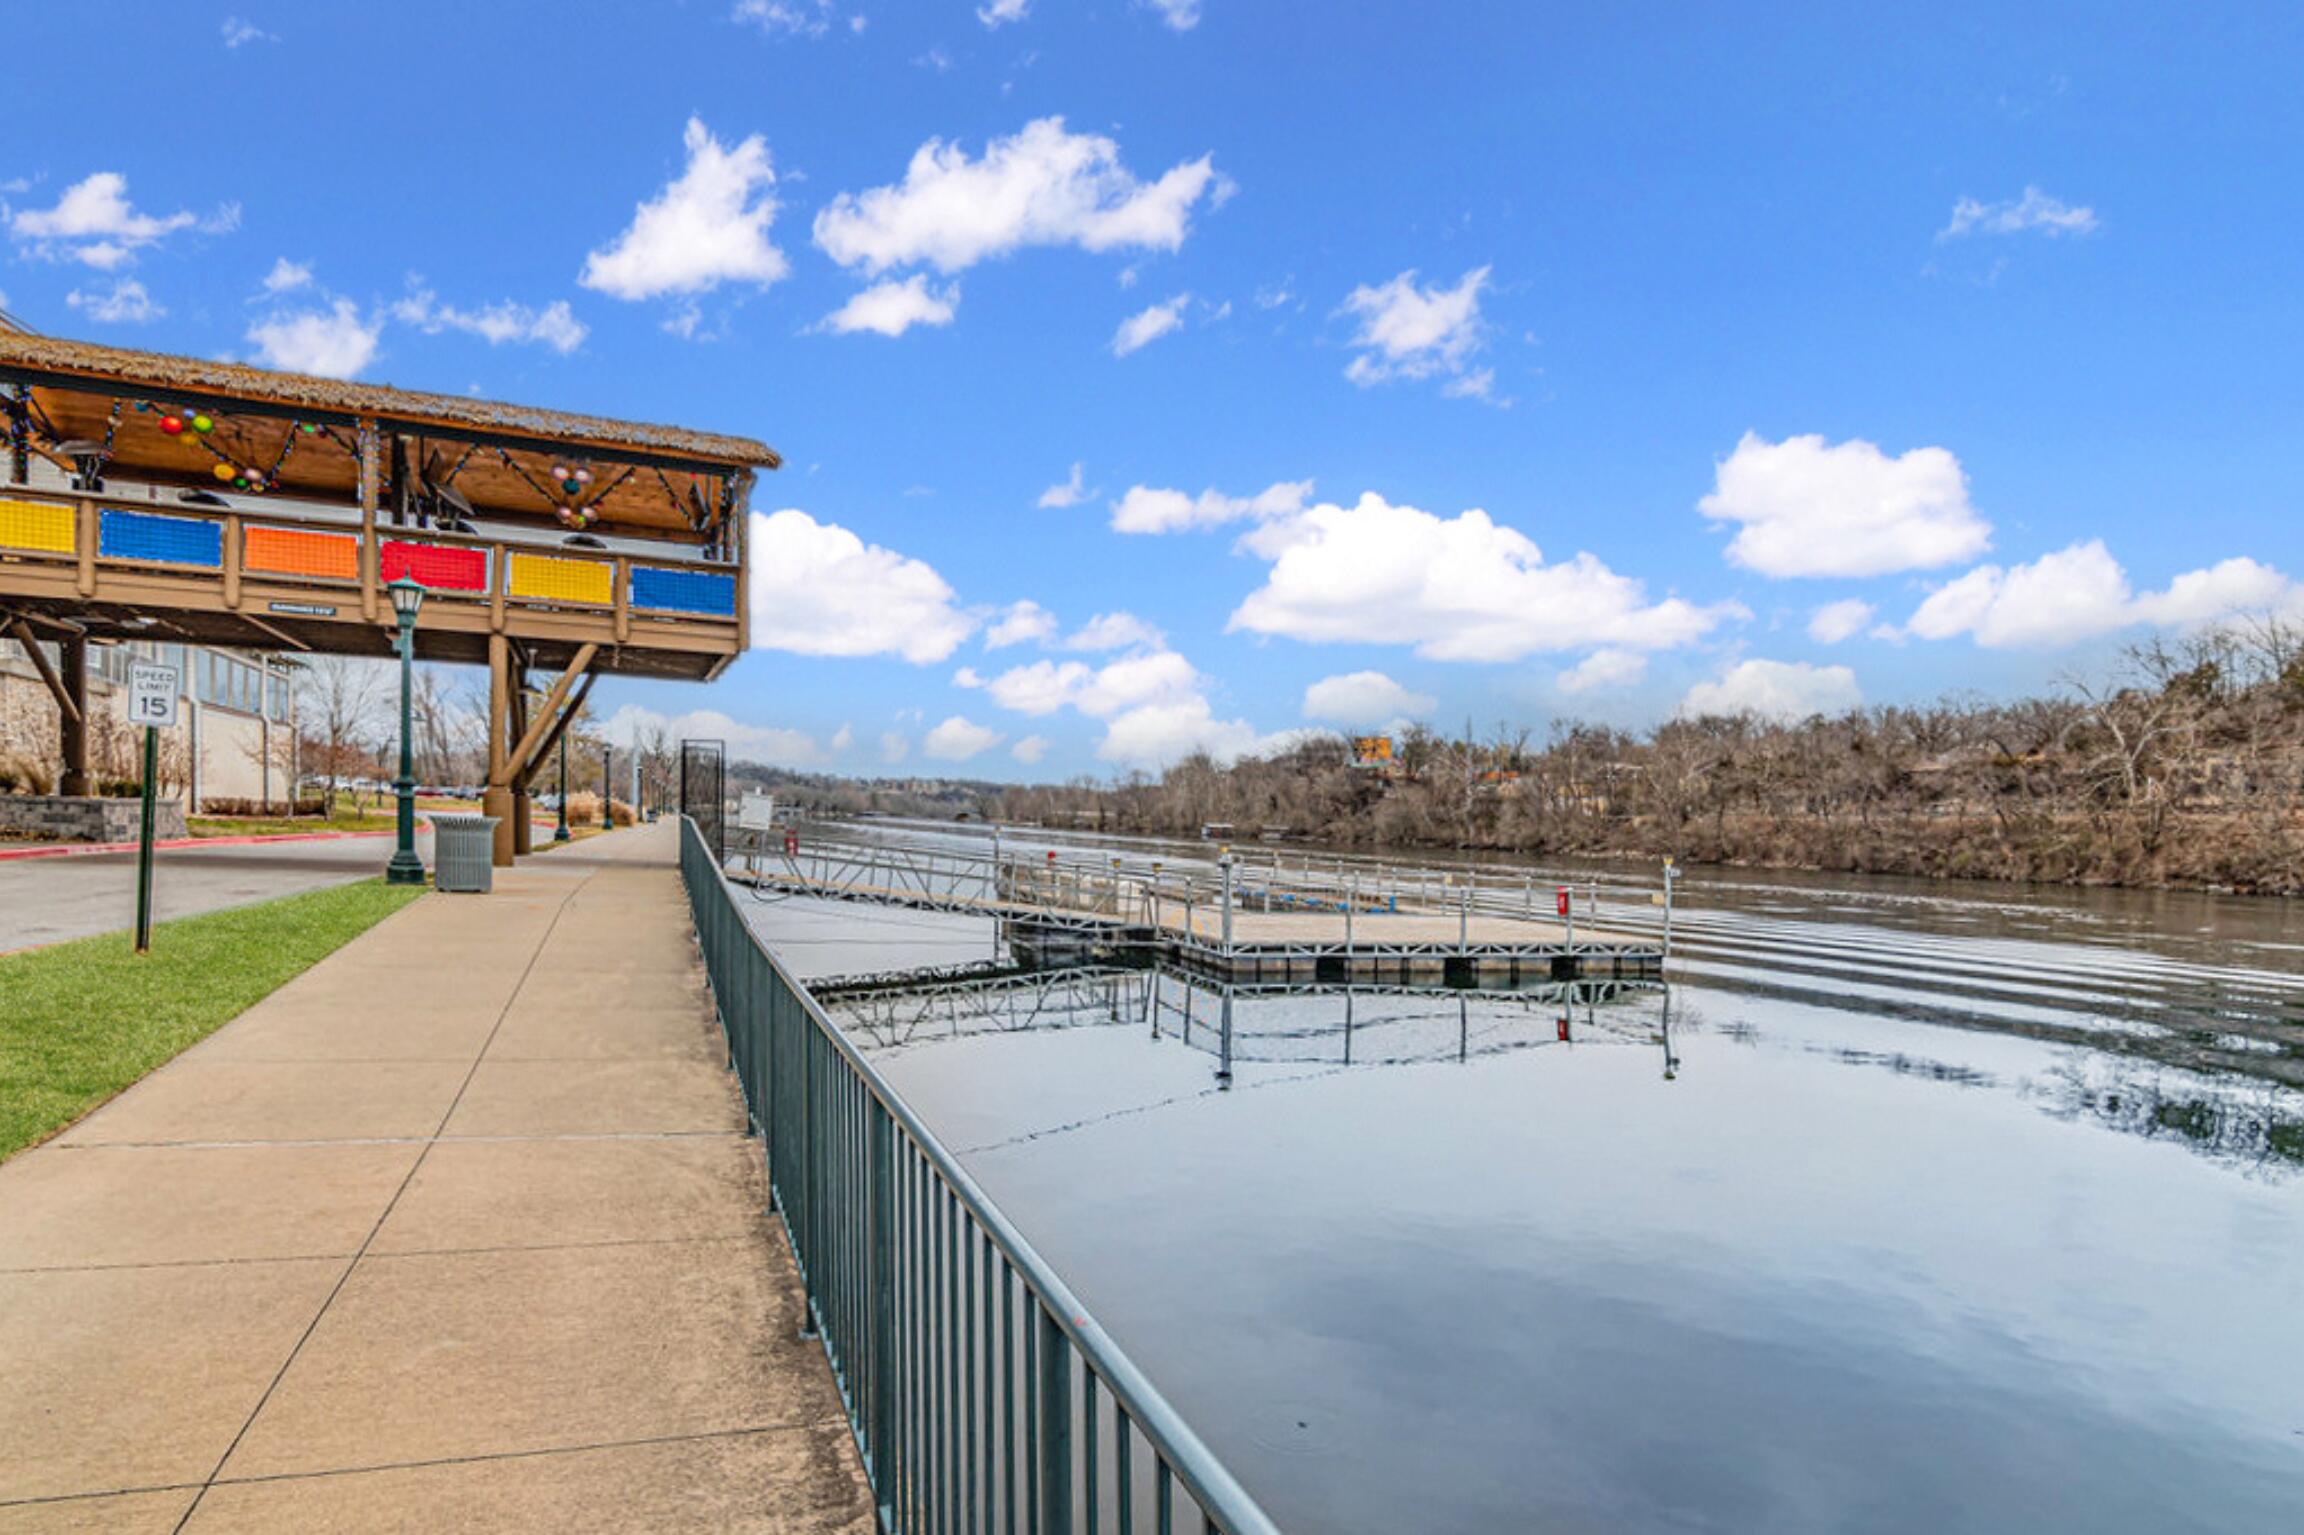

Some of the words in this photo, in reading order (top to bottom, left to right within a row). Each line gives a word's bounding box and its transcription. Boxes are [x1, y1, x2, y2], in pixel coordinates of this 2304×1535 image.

[135, 670, 174, 681] SPEED
[137, 681, 170, 691] LIMIT
[141, 696, 168, 717] 15
